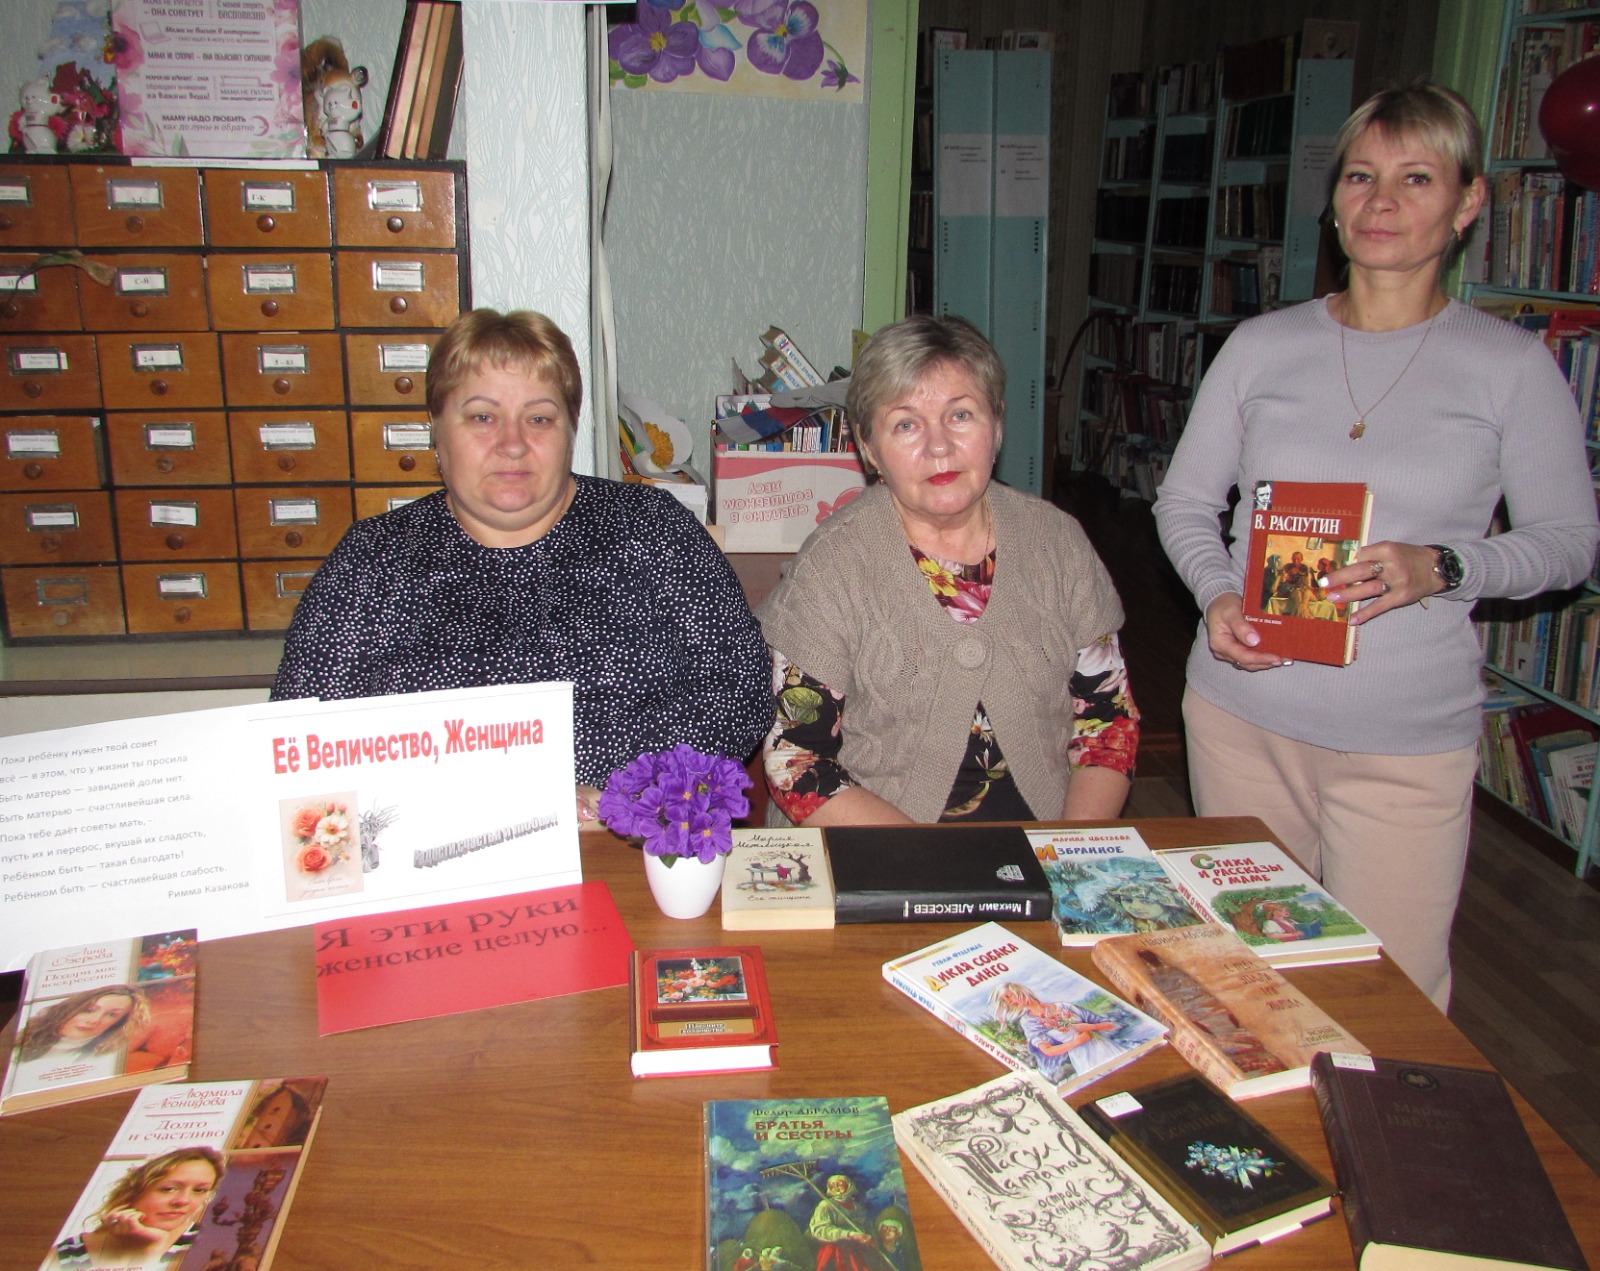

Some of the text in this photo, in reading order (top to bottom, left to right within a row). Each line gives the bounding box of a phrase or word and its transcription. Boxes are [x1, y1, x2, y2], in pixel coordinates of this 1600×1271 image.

[151, 8, 204, 18] ОНА СОВЕТУЕТ
[179, 124, 190, 132] до
[221, 124, 255, 132] обратно
[213, 115, 246, 123] ЛЮБИТЬ
[134, 278, 149, 286] С-Я
[747, 481, 783, 496] ЛЕСУ
[723, 489, 814, 511] ВОЛШЕБНОМ
[730, 505, 809, 524] СДЕЛАНО В
[1254, 514, 1341, 535] В. РАСПУТИН
[1, 738, 158, 766] Пока ребёнку нужен твой совет
[272, 718, 545, 775] Её Величество, Женщина
[0, 774, 17, 784] всё
[31, 772, 38, 780] в
[40, 769, 68, 780] этом,
[70, 767, 87, 776] что
[89, 765, 95, 775] у
[96, 761, 129, 773] жизни
[131, 760, 145, 769] ты
[146, 754, 188, 769] просила
[0, 793, 24, 804] Быть
[26, 787, 71, 802] матерью
[87, 780, 135, 793] завидней
[137, 776, 164, 788] доли
[165, 774, 187, 784] нет.
[0, 813, 25, 824] Быть
[26, 807, 73, 821] матерью
[88, 796, 165, 813] счастливейшая
[167, 792, 194, 803] сила.
[0, 833, 26, 844] Пока
[28, 829, 52, 840] тебе
[54, 825, 78, 839] даёт
[80, 821, 117, 833] советы
[119, 818, 146, 829] мать,
[1, 830, 208, 864] пусть их и перерос, вкушай их сладость,
[1035, 844, 1124, 861] ИЗБРАННОЕ
[3, 868, 56, 883] Ребёнком
[58, 863, 84, 875] быть
[100, 860, 128, 870] такая
[130, 850, 185, 866] благодать!
[1198, 863, 1285, 879] И РАССКАЗЫ
[4, 887, 58, 903] Ребёнком
[59, 883, 86, 895] быть
[101, 871, 178, 890] счастливейшая
[180, 864, 229, 878] слабость.
[168, 880, 250, 899] Римма Казакова
[1212, 874, 1271, 886] О МАМЕ
[913, 903, 1022, 915] Михаил АЛЕКСЕЕВ
[316, 897, 579, 952] Я эти руки
[315, 942, 463, 978] женские
[923, 961, 975, 992] ДИКАЯ
[972, 942, 1019, 967] СОБАКА
[965, 962, 1010, 987] ДИНГО
[796, 1107, 861, 1117] АБРАМОВ
[154, 1119, 208, 1131] Долго
[755, 1120, 825, 1131] БРАТЬЯ
[128, 1130, 225, 1141] и счастливо
[755, 1130, 854, 1142] И СЕСТРЫ
